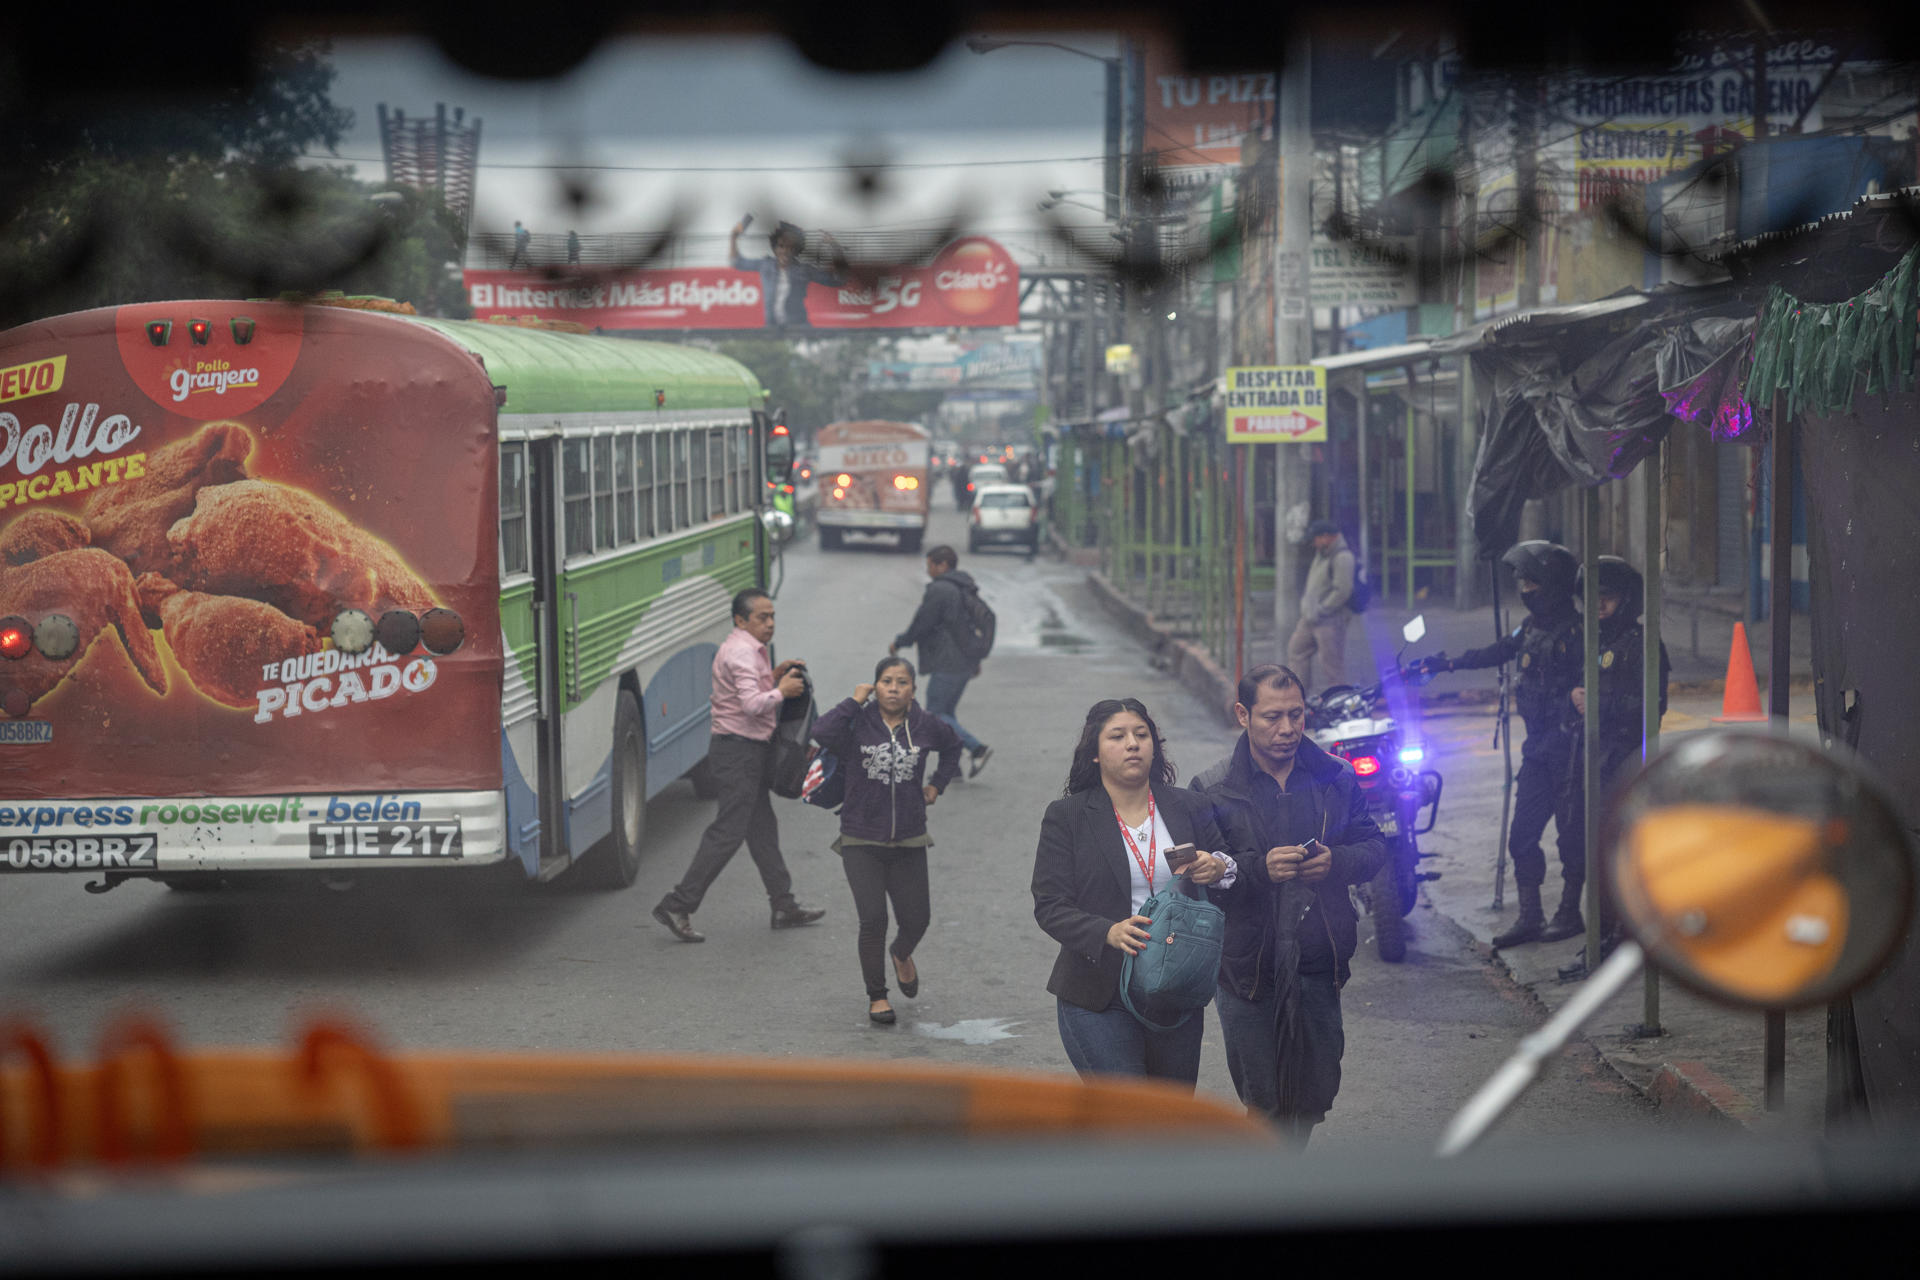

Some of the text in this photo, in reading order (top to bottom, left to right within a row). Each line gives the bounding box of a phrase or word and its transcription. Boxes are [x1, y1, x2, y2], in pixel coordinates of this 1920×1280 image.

[1157, 72, 1276, 109] TU PIZZ
[1576, 76, 1811, 116] FARMACIAS GAENO
[1580, 128, 1667, 159] SERVICIO
[471, 279, 759, 312] El Internet Más Rápido
[872, 276, 921, 313] 5G
[935, 269, 997, 290] Claro
[0, 362, 54, 400] EVO
[196, 360, 230, 373] Pollo
[1236, 370, 1315, 388] RESPETAR
[170, 368, 259, 402] granjero
[1229, 389, 1323, 407] ENTRADA DE
[0, 452, 146, 509] PICANTE
[262, 662, 280, 682] TE
[254, 658, 438, 724] PICADO
[0, 805, 135, 834] express
[139, 797, 304, 826] roosevelt
[326, 796, 421, 823] belén
[317, 825, 458, 856] TIE 217
